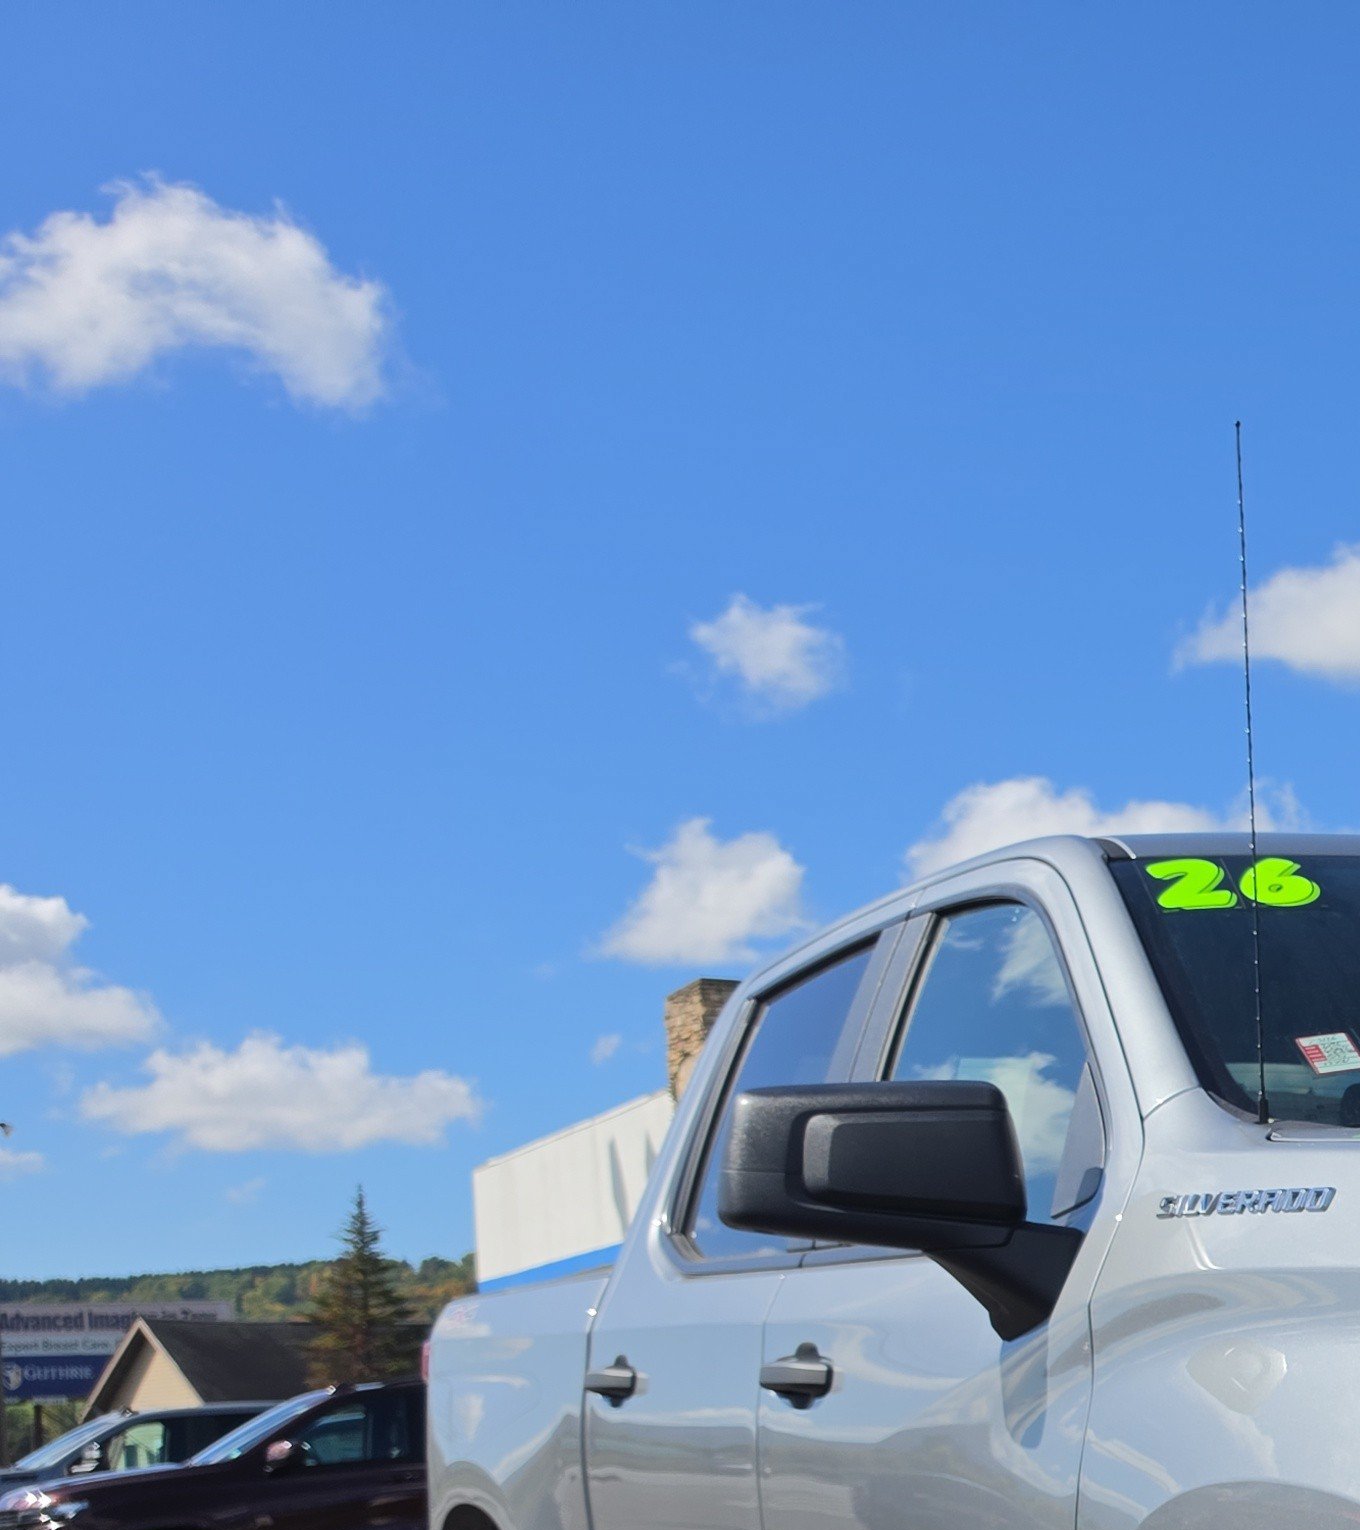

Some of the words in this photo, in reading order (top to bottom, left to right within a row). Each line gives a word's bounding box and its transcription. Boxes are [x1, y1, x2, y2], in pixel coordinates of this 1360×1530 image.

[1145, 858, 1321, 911] 26
[1156, 1186, 1337, 1220] SILVERADO
[0, 1310, 84, 1332] Advanced
[24, 1364, 93, 1381] GUTHRIE
